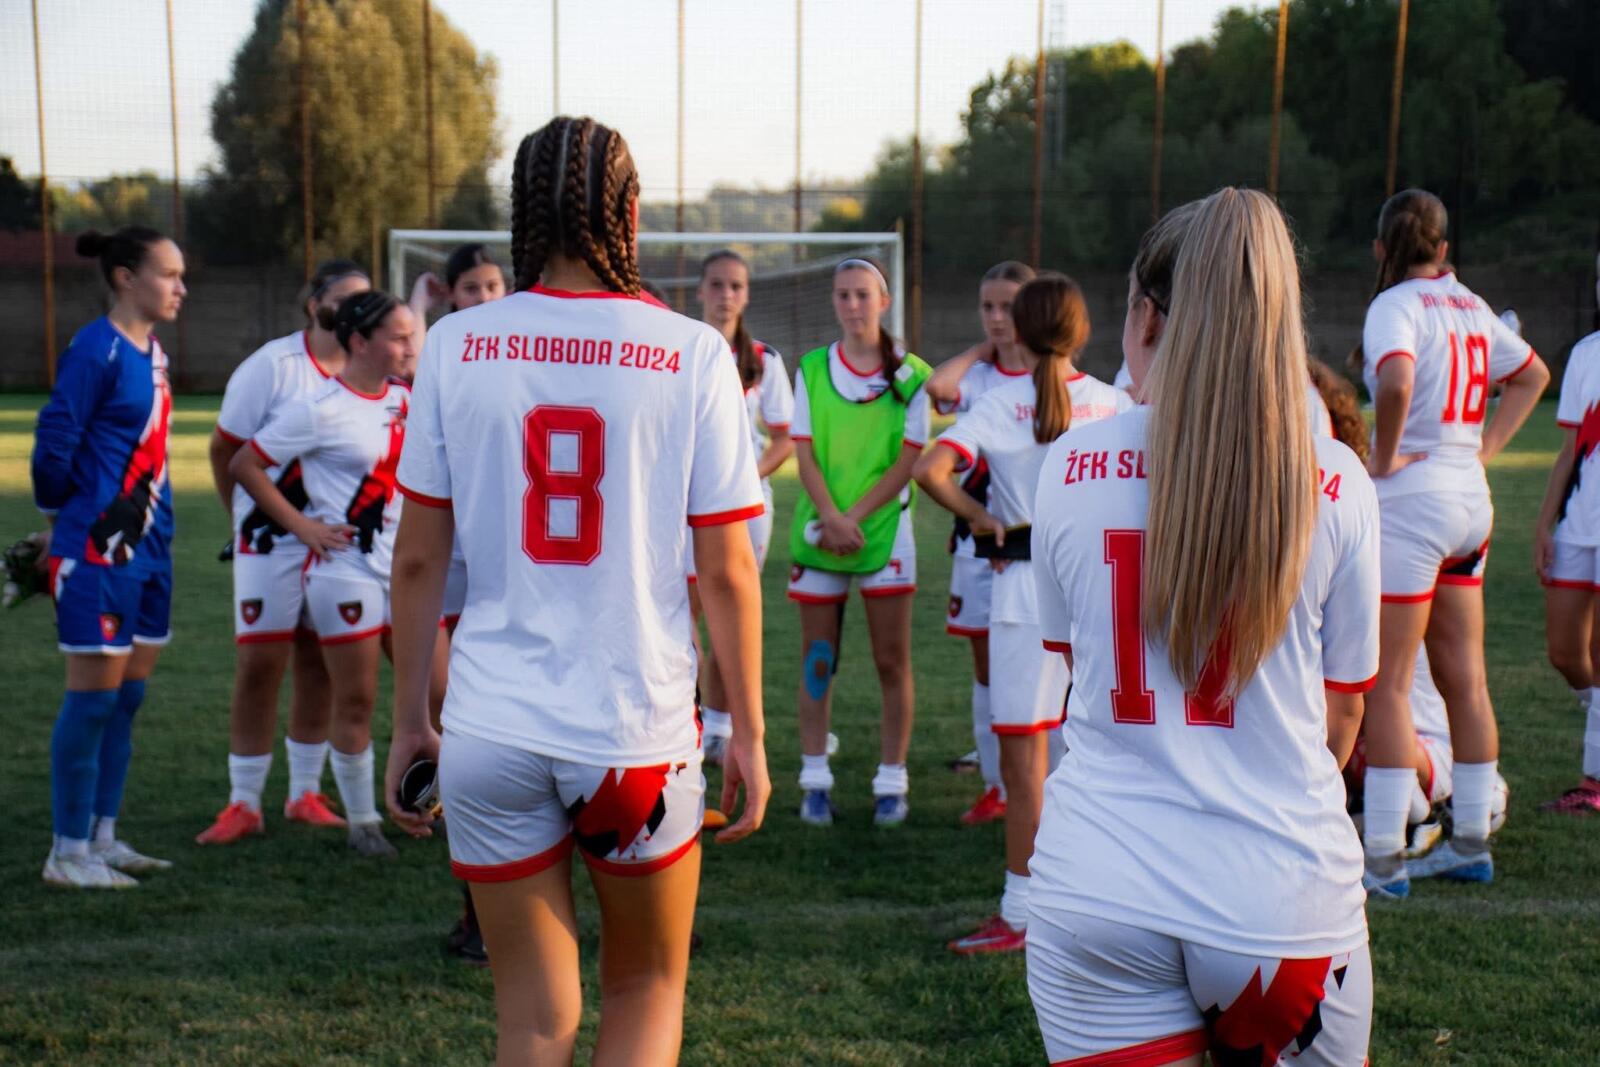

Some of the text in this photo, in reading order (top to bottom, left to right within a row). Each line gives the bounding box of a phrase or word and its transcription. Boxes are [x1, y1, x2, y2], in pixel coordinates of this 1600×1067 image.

[461, 332, 681, 374] ŽFK SLOBODA 2024
[1440, 328, 1489, 425] 18
[521, 404, 606, 567] 8
[1064, 449, 1108, 486] ŽFK
